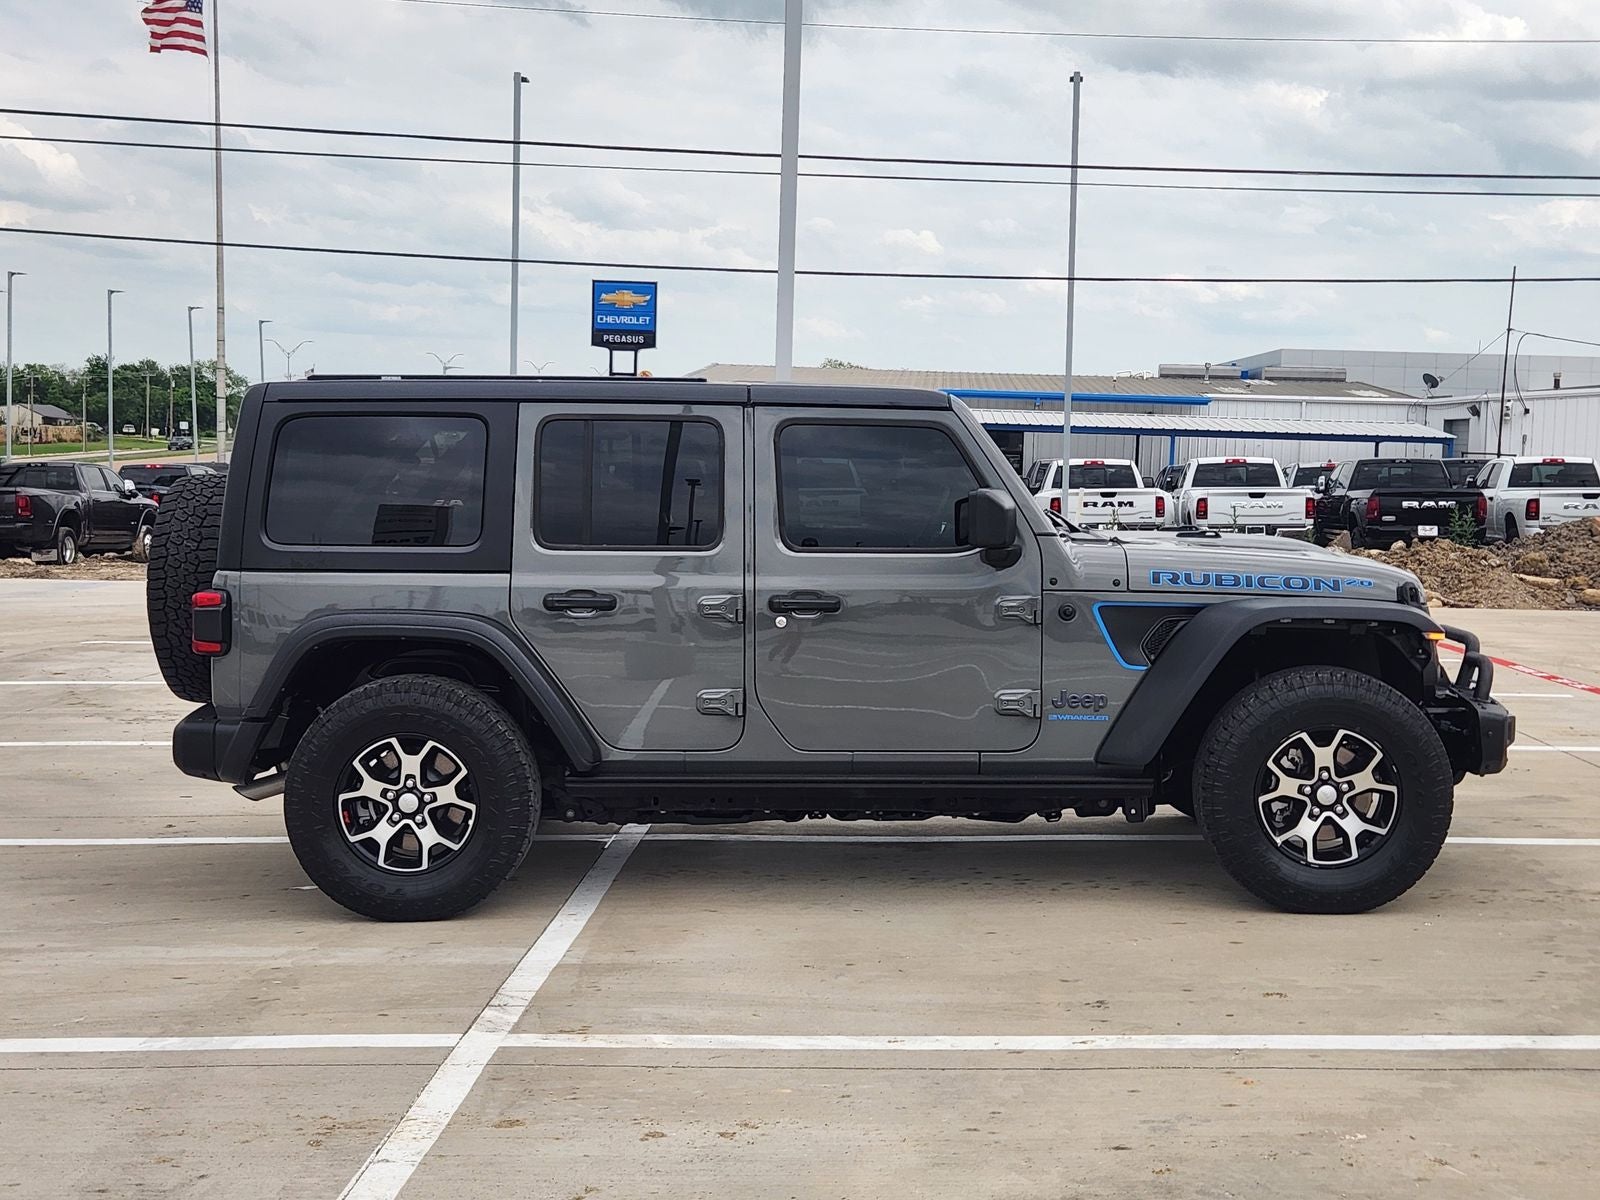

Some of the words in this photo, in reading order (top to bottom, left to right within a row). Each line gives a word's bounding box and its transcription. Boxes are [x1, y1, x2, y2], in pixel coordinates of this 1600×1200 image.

[597, 315, 652, 324] CHEVROLET
[603, 335, 644, 343] PEGASUS
[1230, 501, 1284, 509] RAM
[1402, 501, 1457, 509] RAM
[1150, 569, 1343, 593] RUBICON
[1051, 689, 1108, 712] Jeep
